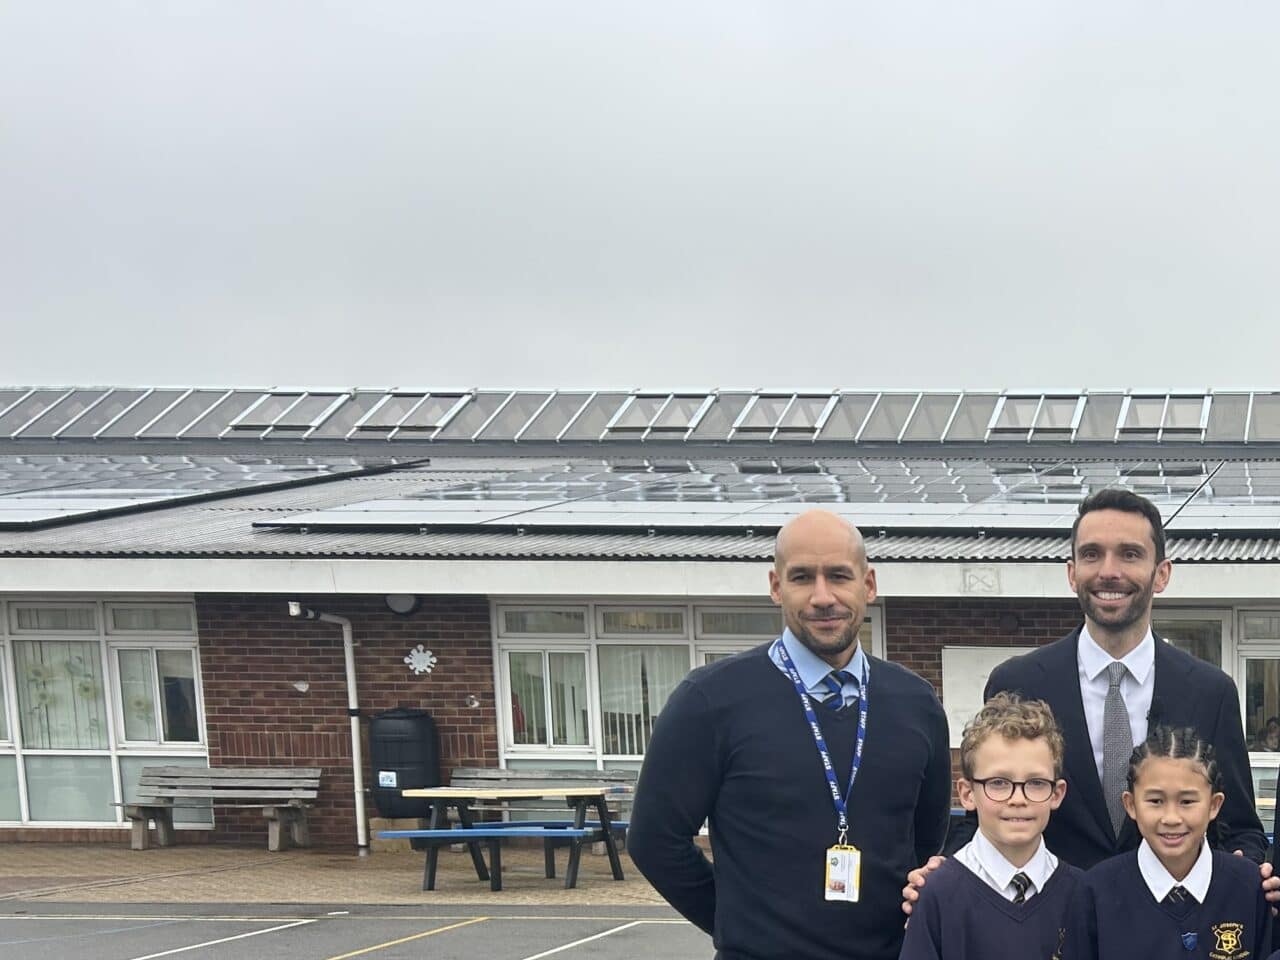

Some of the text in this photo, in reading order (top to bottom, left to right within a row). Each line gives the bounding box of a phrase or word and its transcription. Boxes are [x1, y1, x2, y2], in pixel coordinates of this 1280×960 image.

[811, 722, 822, 740] STAFF
[821, 751, 832, 770] STAFF
[830, 781, 840, 800] STAFF
